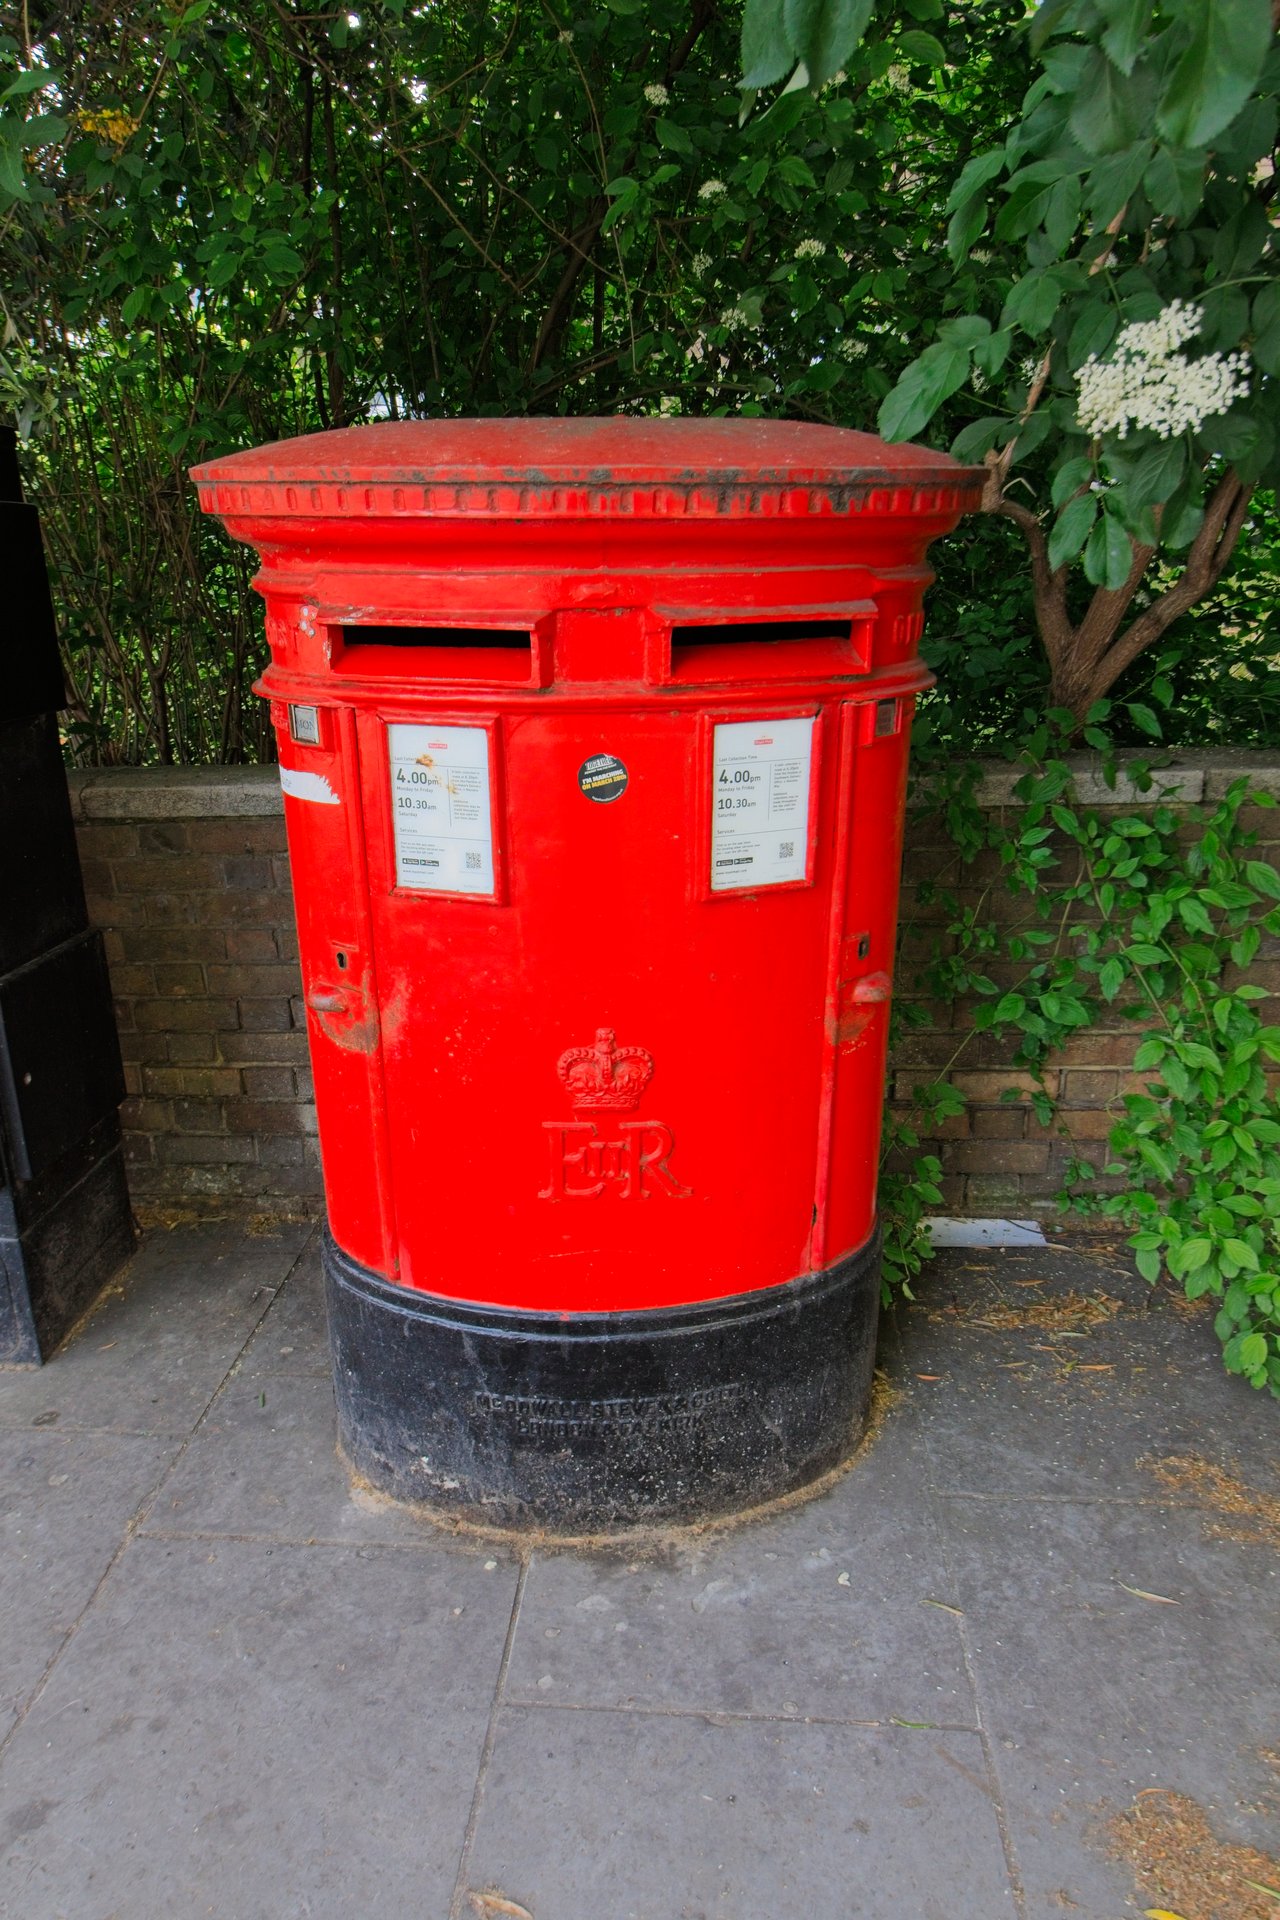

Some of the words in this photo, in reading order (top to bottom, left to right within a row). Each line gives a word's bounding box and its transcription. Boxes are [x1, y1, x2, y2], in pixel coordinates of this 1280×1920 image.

[396, 768, 440, 785] 4.00pm
[719, 769, 761, 784] 4.00pm
[398, 797, 437, 810] 10.30am
[718, 798, 756, 810] 10.30am
